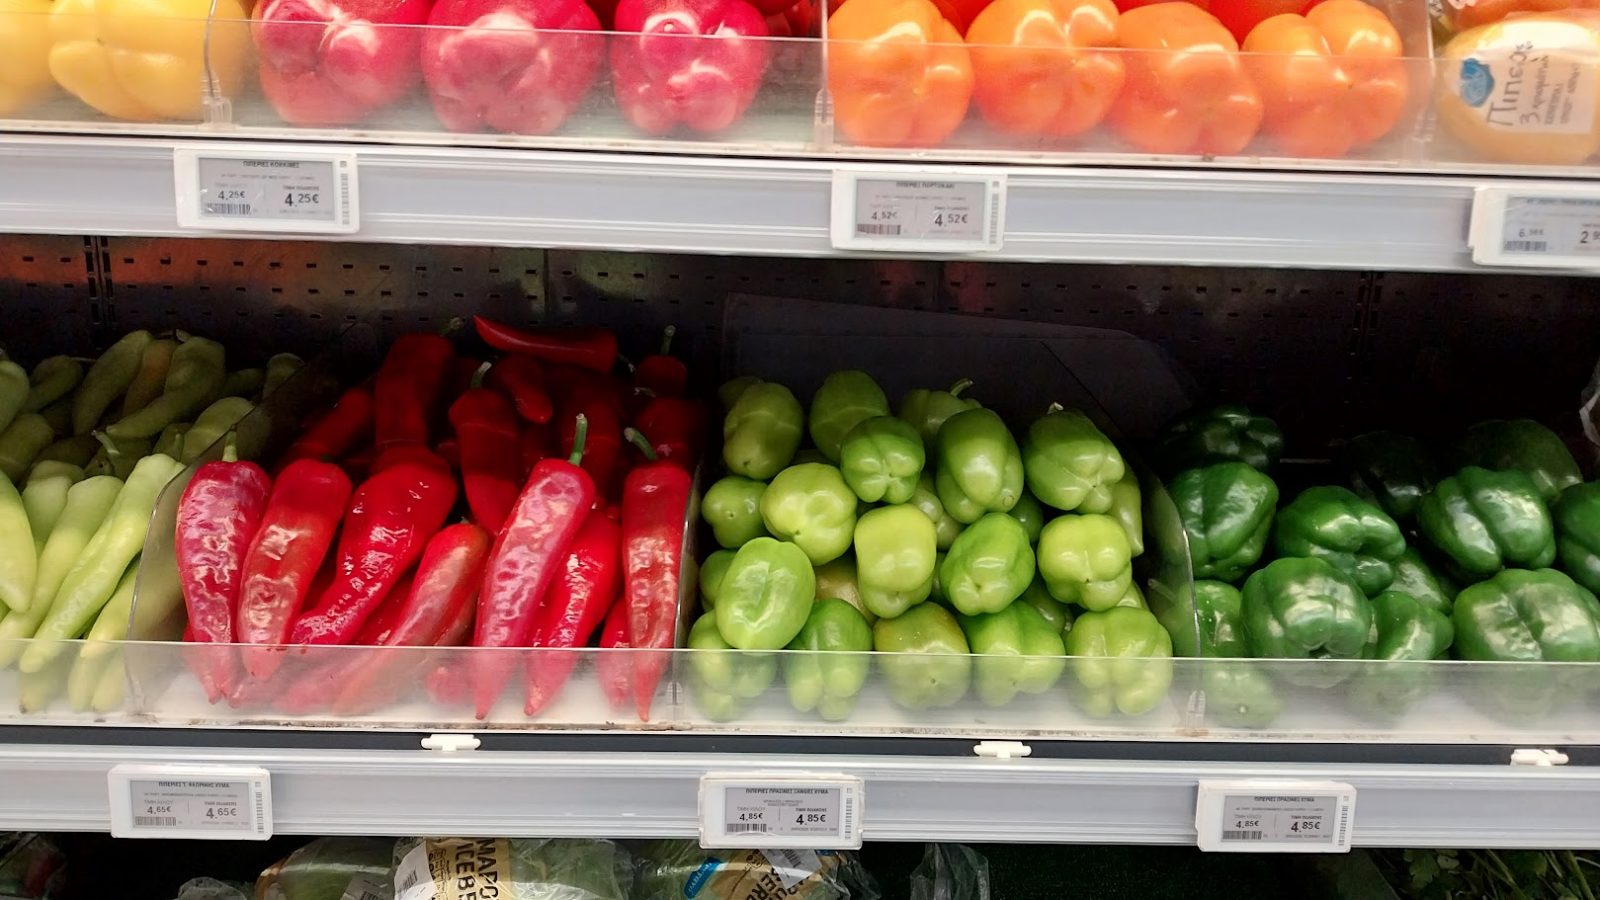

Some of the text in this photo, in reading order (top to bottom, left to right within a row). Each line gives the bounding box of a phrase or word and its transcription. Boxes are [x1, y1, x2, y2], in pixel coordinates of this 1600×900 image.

[218, 190, 246, 200] 4.25€
[285, 193, 319, 207] 4.25€
[934, 213, 969, 227] 4.52€
[147, 806, 172, 815] 4.65€
[206, 807, 237, 819] 4.65€
[739, 812, 764, 821] 4.85€
[796, 814, 826, 825] 4.85€
[1236, 820, 1259, 829] 4.85€
[1291, 821, 1321, 832] 4.85€
